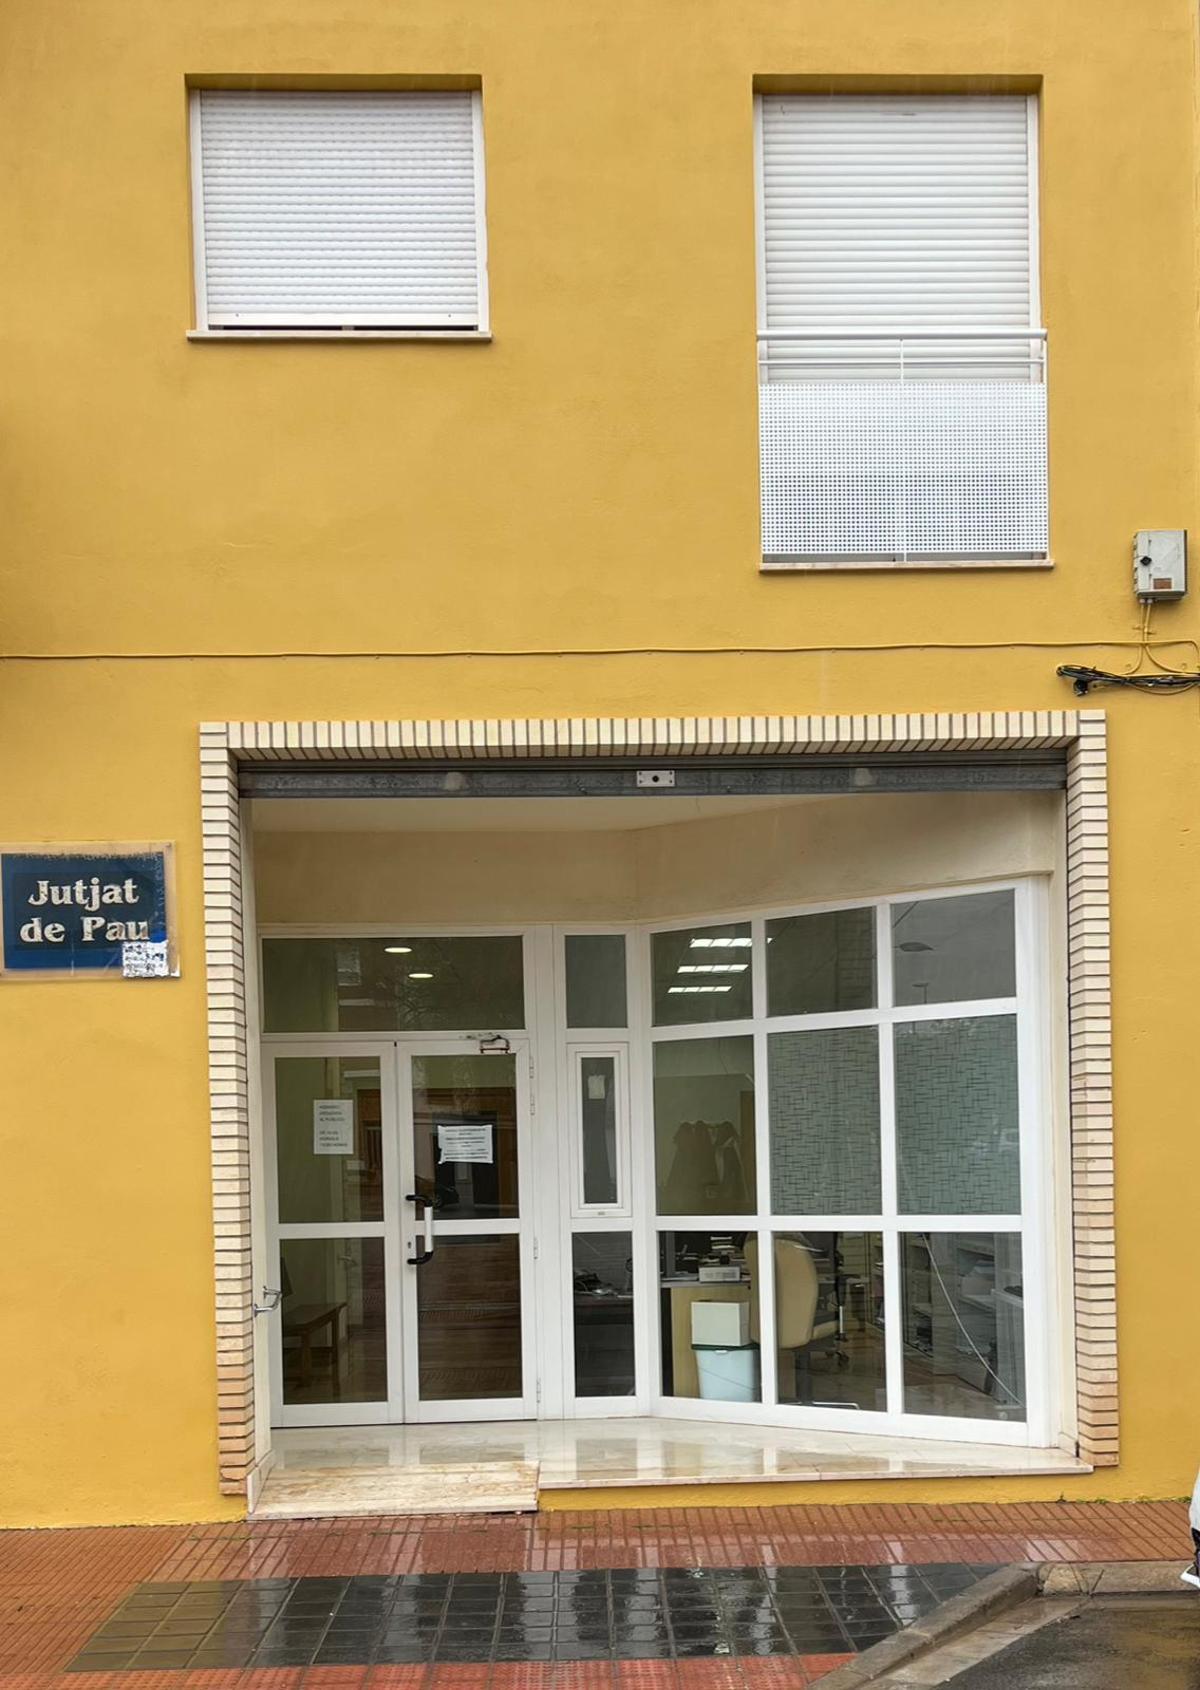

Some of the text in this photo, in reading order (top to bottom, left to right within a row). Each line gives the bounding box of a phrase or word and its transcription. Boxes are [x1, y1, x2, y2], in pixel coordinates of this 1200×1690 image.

[28, 877, 140, 912] Jutjat
[20, 916, 150, 942] de Pau
